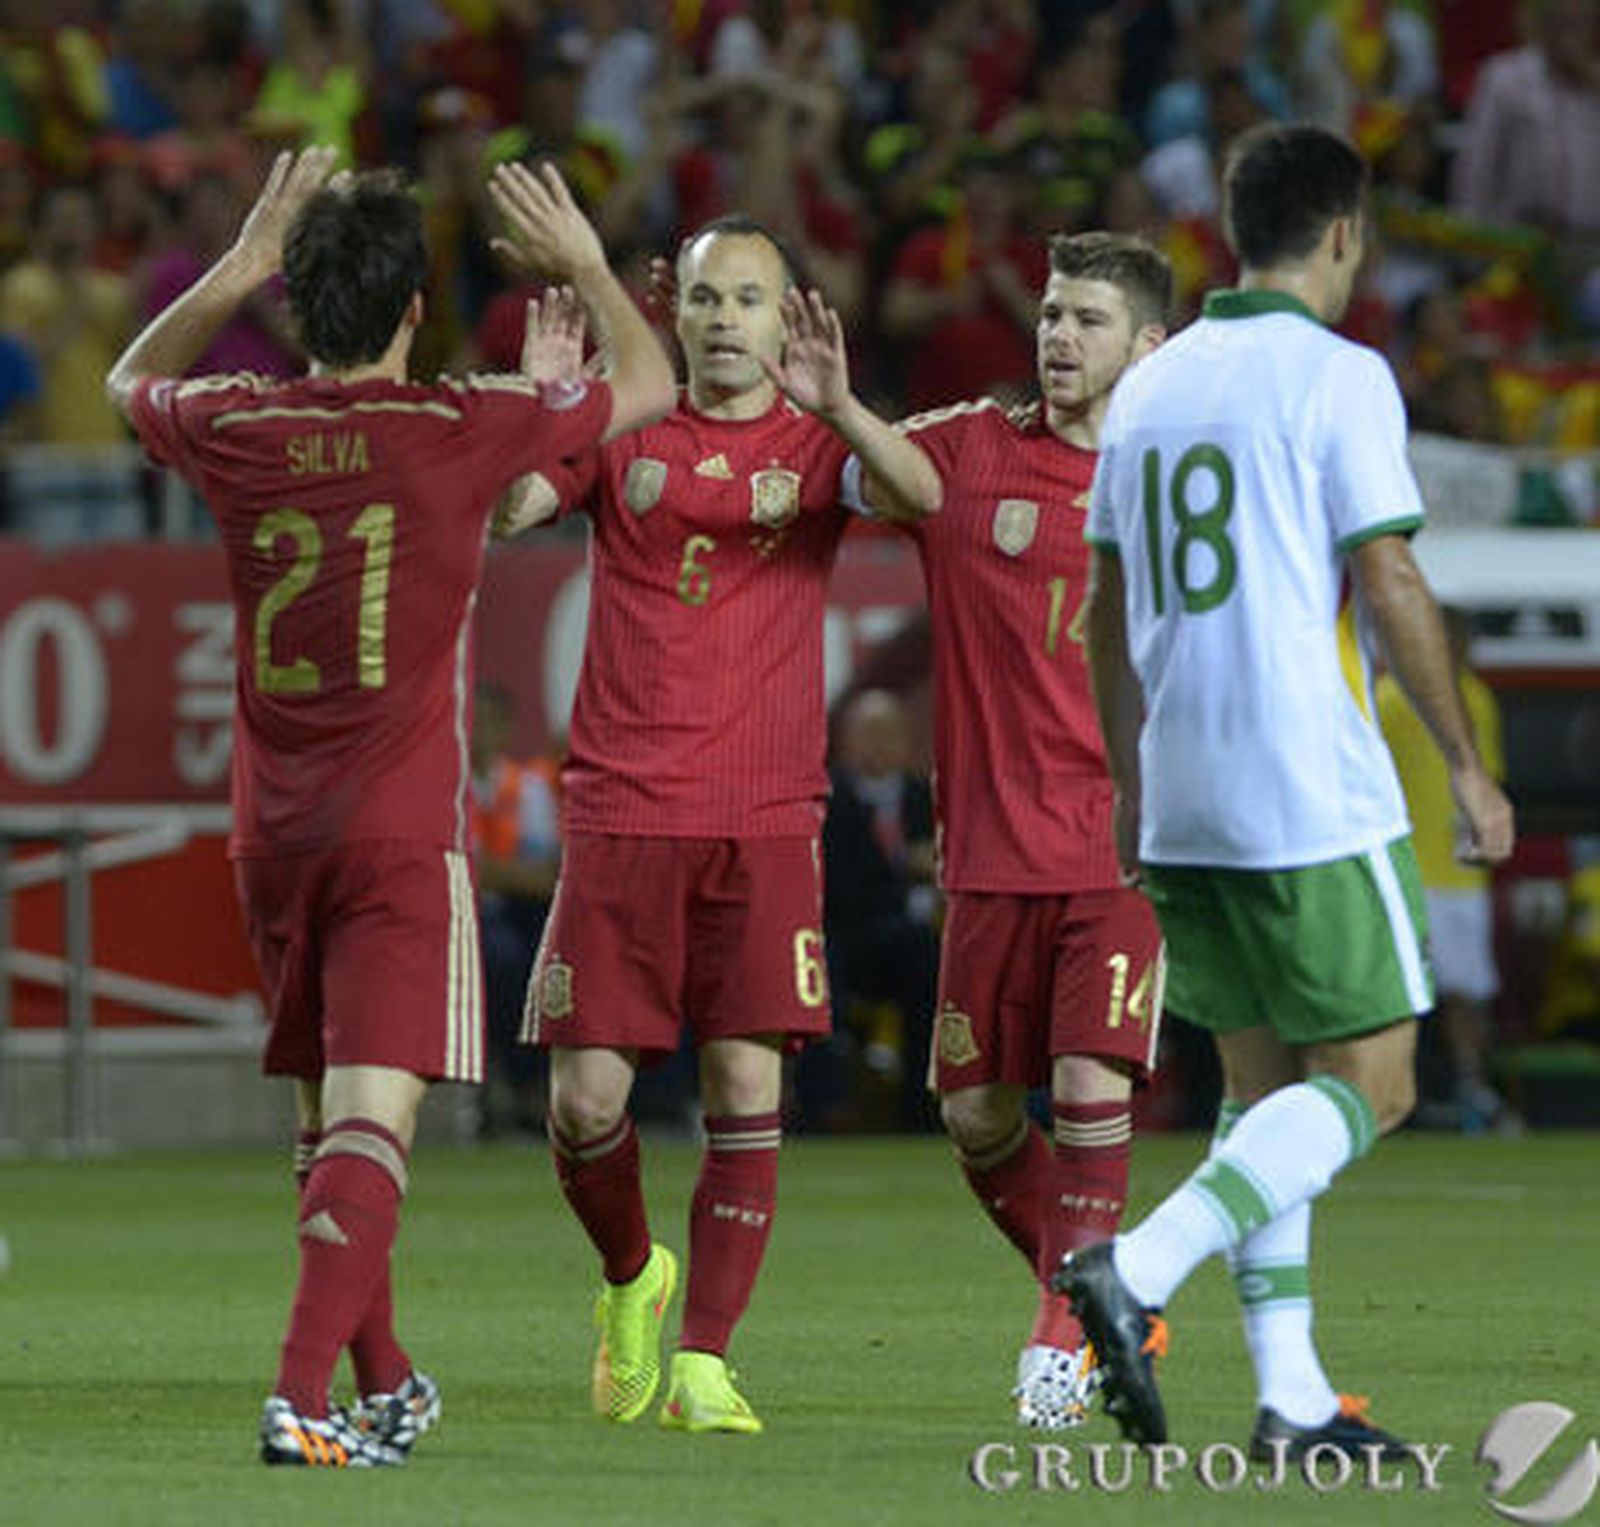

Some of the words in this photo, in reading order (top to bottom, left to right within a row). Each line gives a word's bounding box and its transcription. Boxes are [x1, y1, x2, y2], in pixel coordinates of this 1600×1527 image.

[286, 430, 368, 475] SILVA
[1143, 443, 1237, 617] 18
[252, 503, 395, 693] 21
[677, 535, 716, 607] 6
[794, 928, 825, 1007] 6
[1107, 953, 1156, 1032] 14
